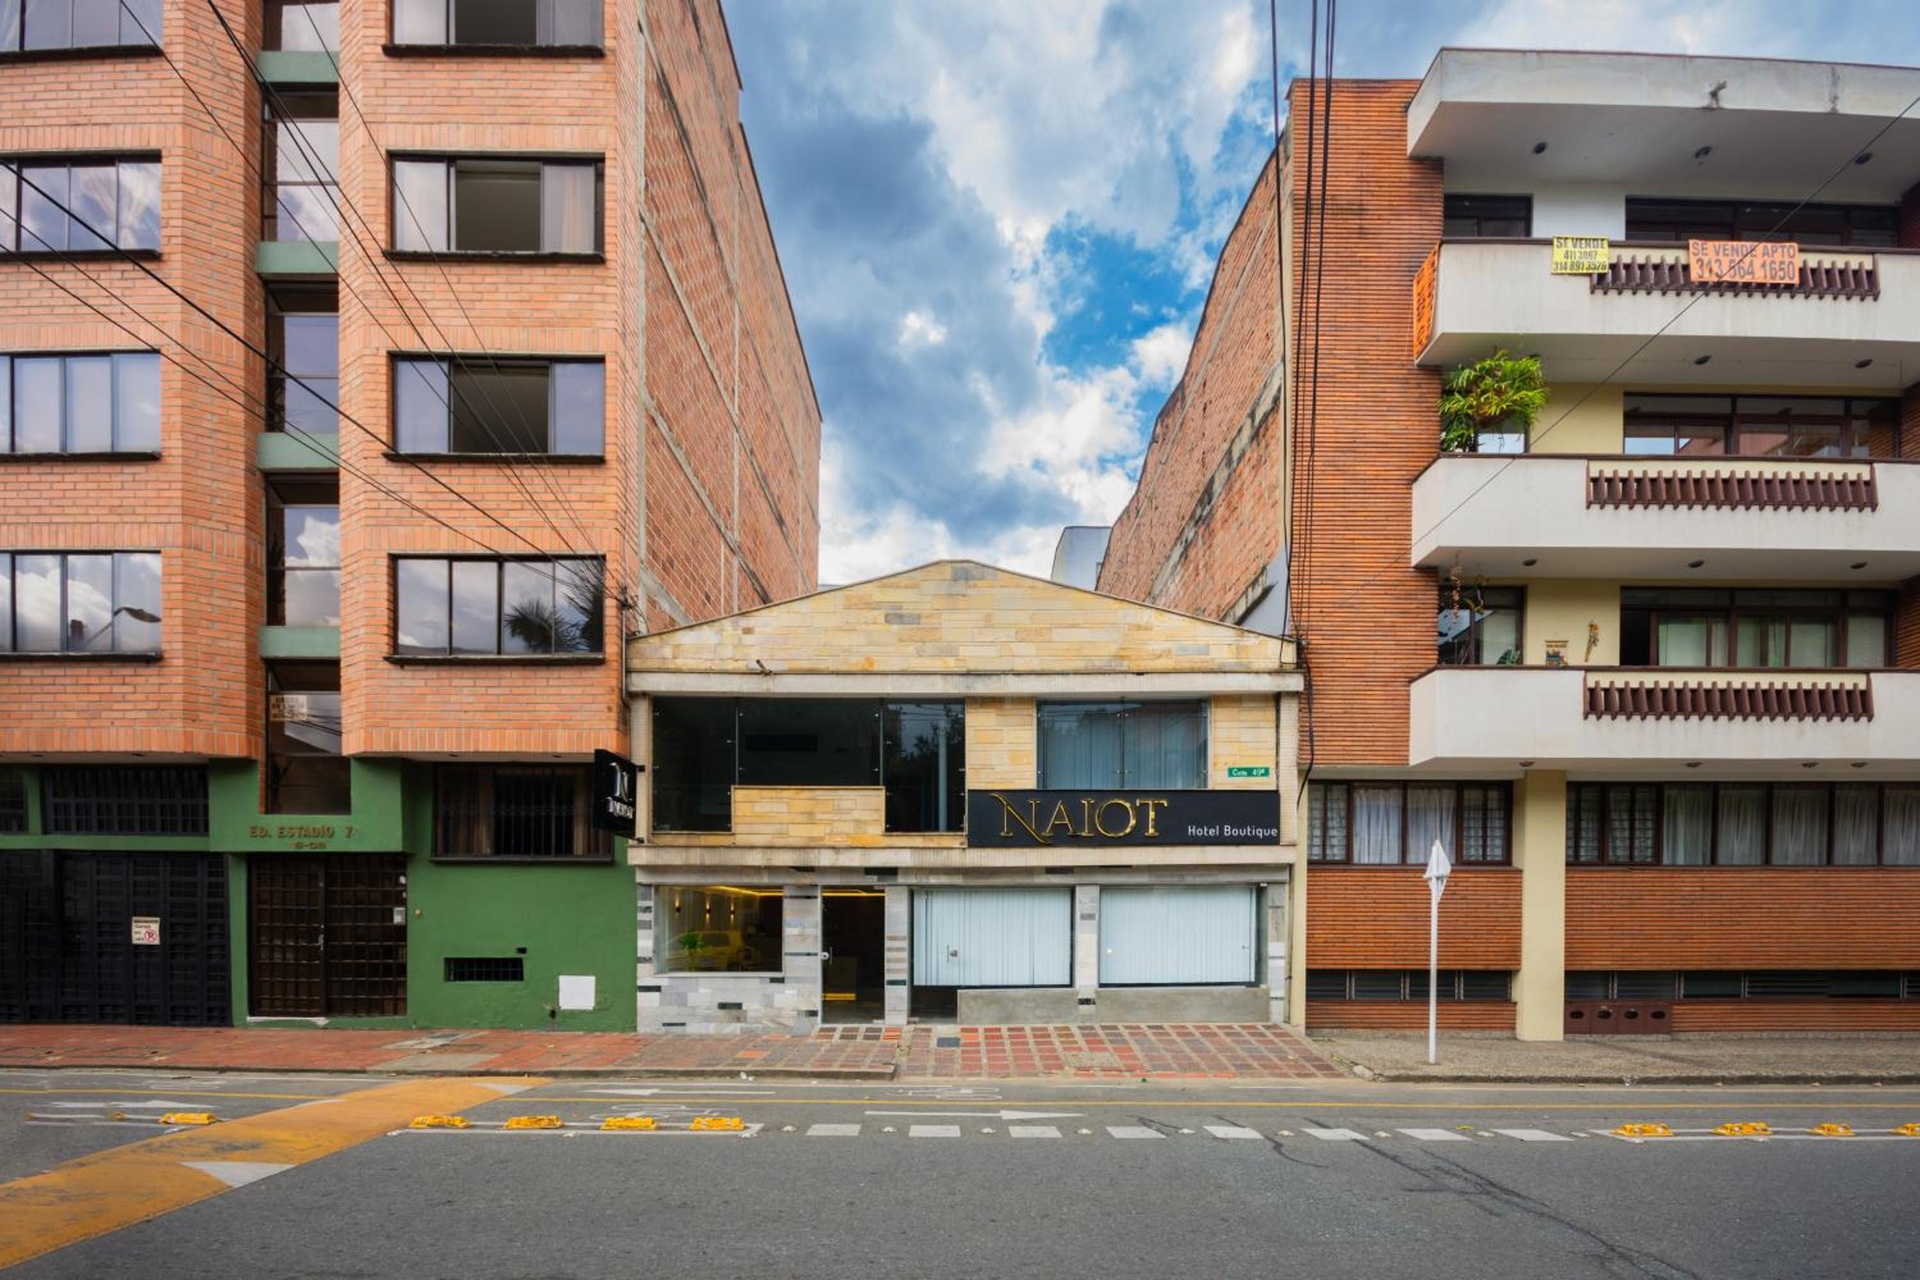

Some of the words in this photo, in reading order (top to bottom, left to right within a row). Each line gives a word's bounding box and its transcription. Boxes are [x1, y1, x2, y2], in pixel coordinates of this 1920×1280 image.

[1556, 237, 1569, 248] SE
[1571, 237, 1606, 249] VENDE
[1691, 241, 1708, 256] SE
[1713, 243, 1757, 257] VENDE
[1762, 244, 1796, 259] APTO
[1696, 258, 1723, 278] 313
[1729, 259, 1755, 279] 564
[1761, 260, 1795, 280] 1650
[990, 793, 1168, 844] NAIOT
[277, 826, 335, 838] ESTADIO
[1188, 825, 1219, 836] Hotel
[1224, 825, 1278, 839] Boutique
